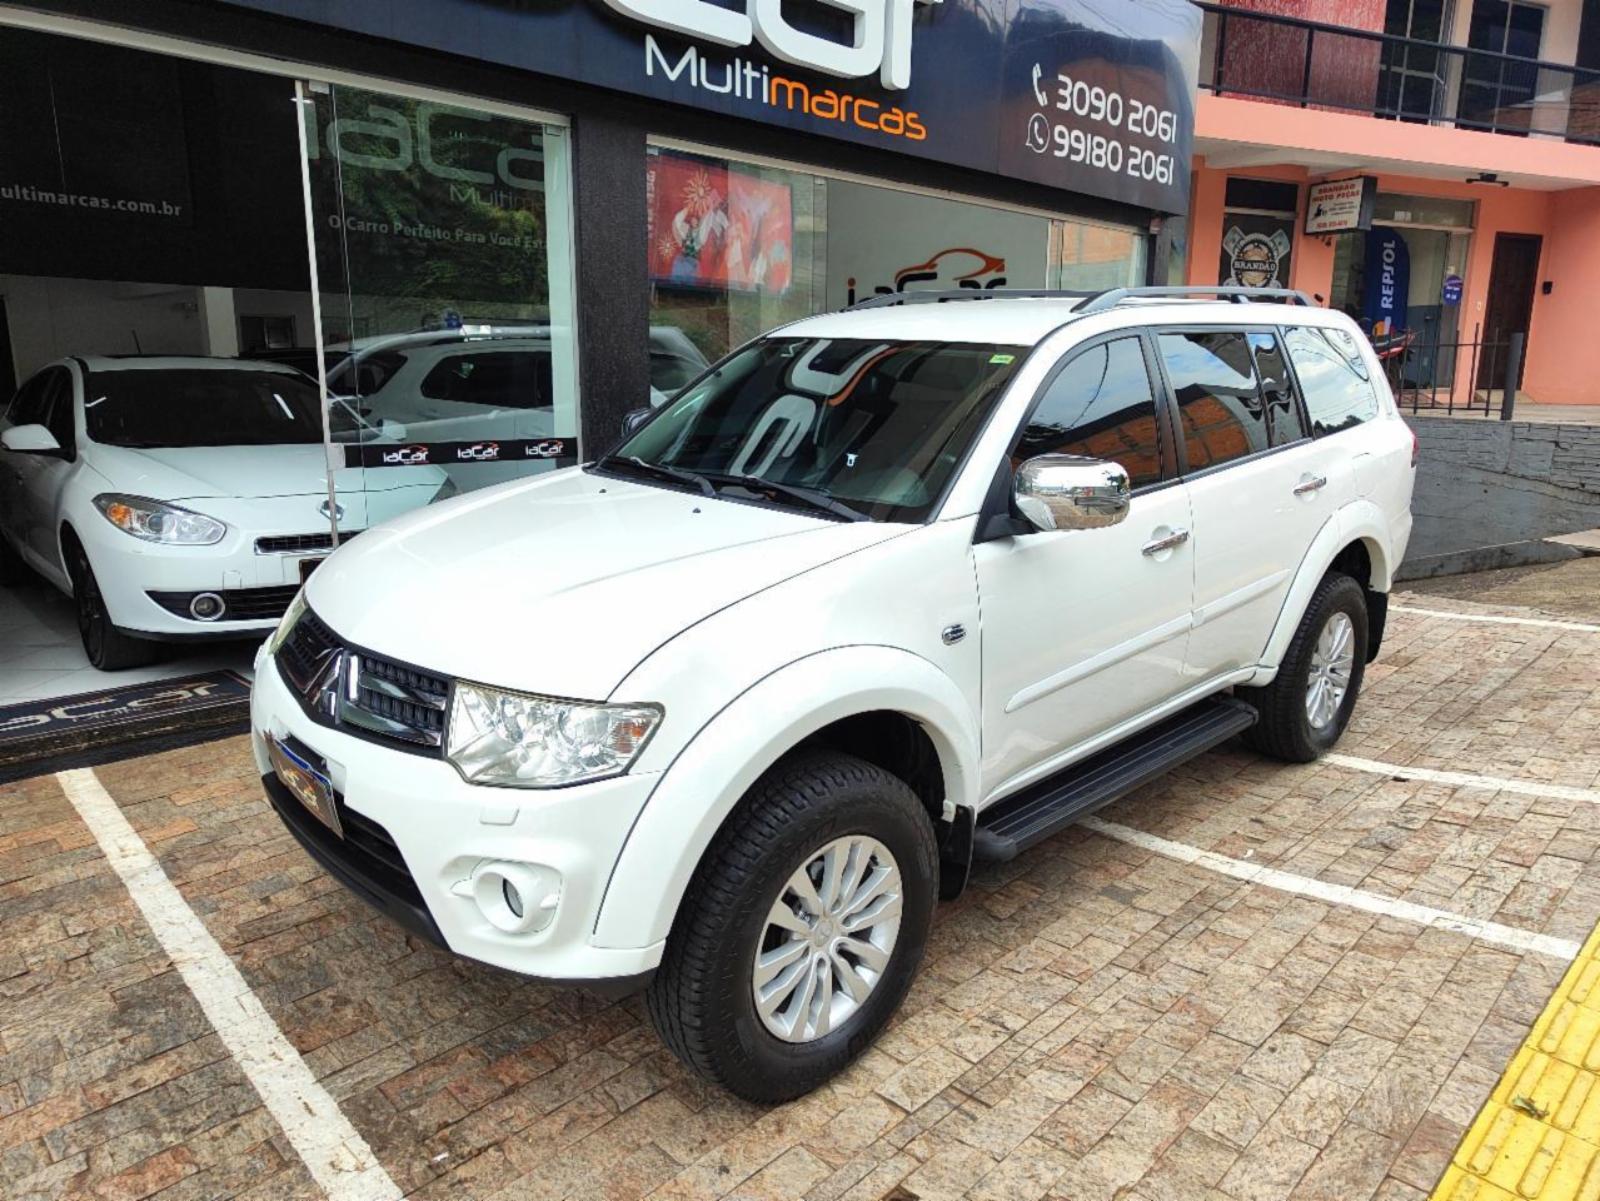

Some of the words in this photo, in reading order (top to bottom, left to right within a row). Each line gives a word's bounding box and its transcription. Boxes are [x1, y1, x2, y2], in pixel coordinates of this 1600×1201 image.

[645, 33, 927, 141] Multimarcas
[1056, 74, 1123, 127] 3090
[1128, 98, 1177, 144] 2061
[1053, 124, 1123, 172] 99180
[1127, 145, 1174, 186] 2061
[328, 215, 341, 228] O
[346, 217, 389, 234] Carro
[393, 221, 452, 241] Perfeito
[454, 228, 486, 245] Para
[1381, 239, 1396, 309] REPSOL
